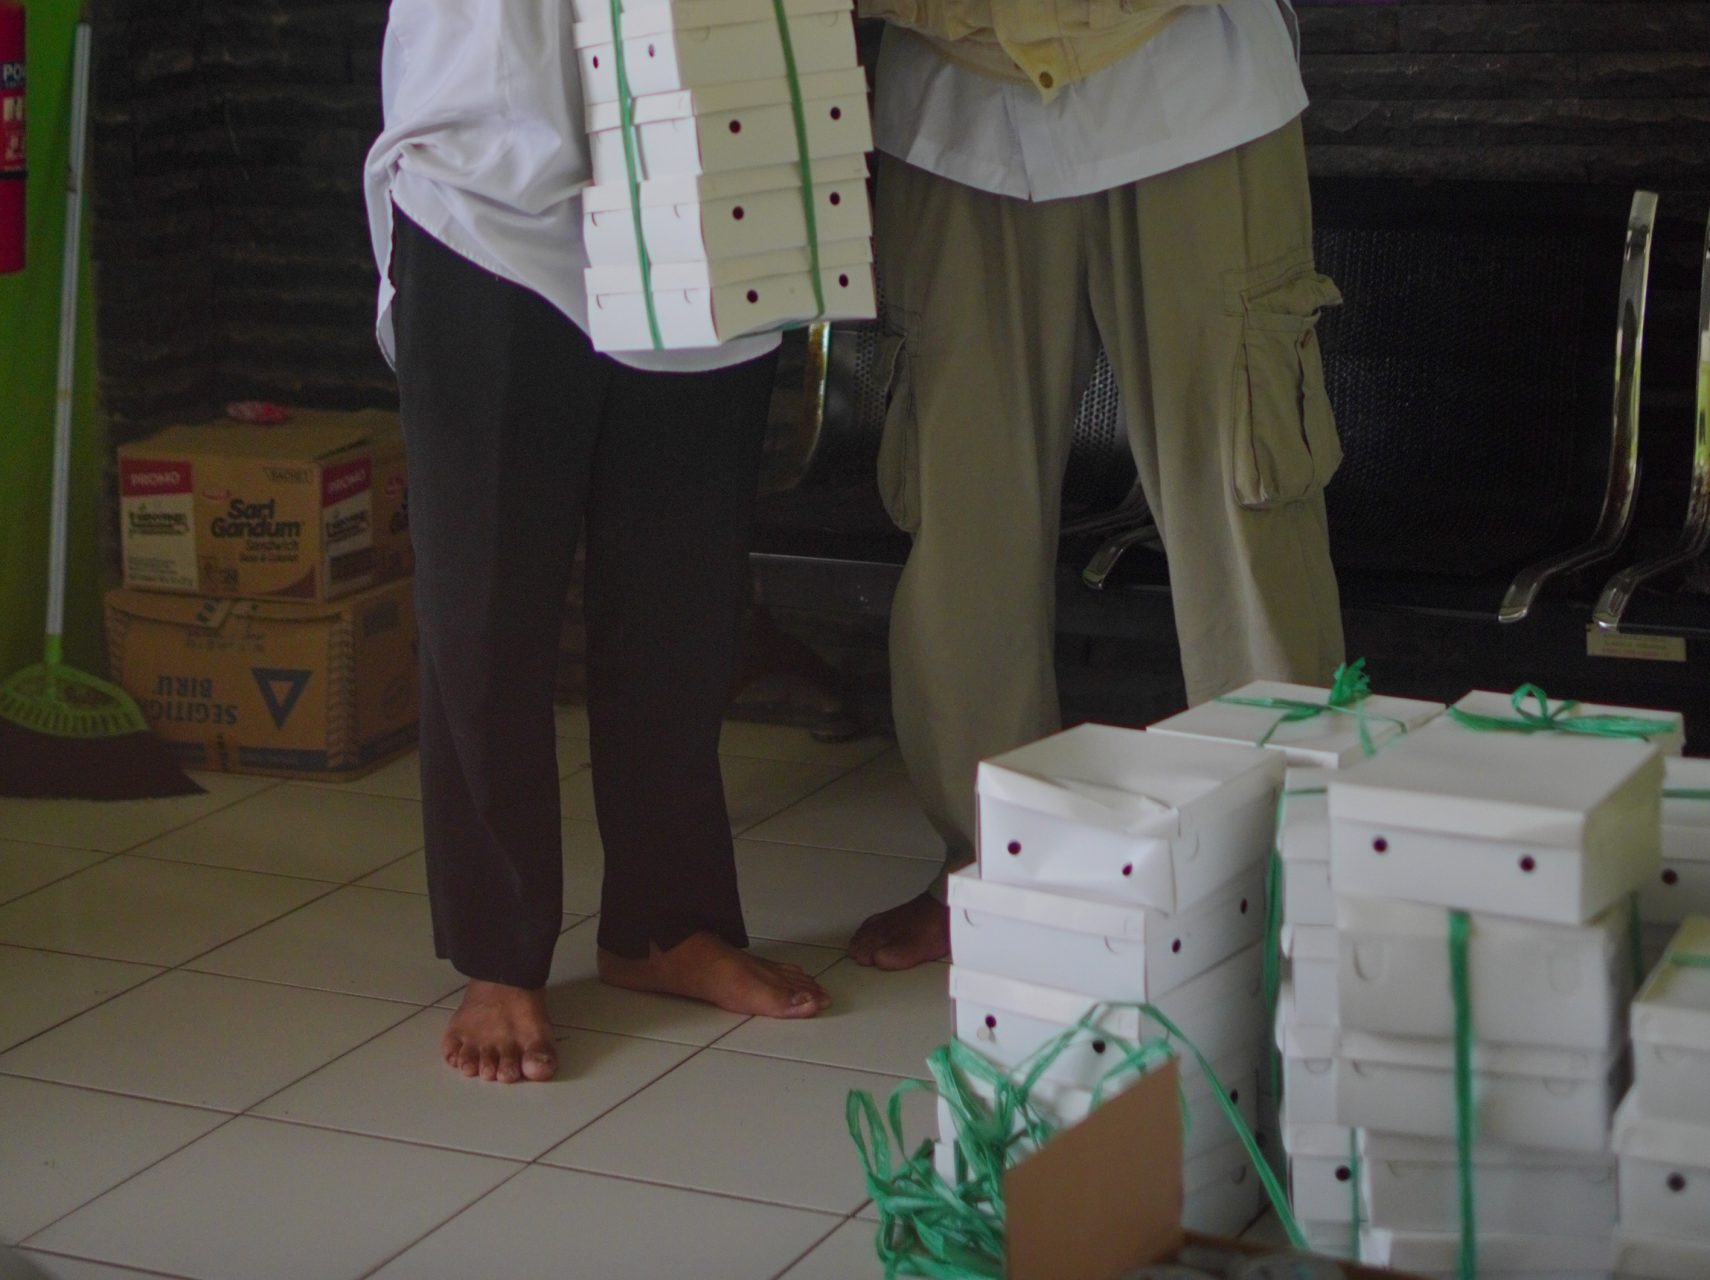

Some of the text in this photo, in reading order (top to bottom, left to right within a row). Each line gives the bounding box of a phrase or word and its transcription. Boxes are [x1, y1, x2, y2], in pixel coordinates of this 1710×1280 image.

[130, 471, 180, 486] PROMO
[228, 498, 275, 520] Sari
[211, 517, 300, 538] Gandum
[157, 675, 212, 697] BIRU
